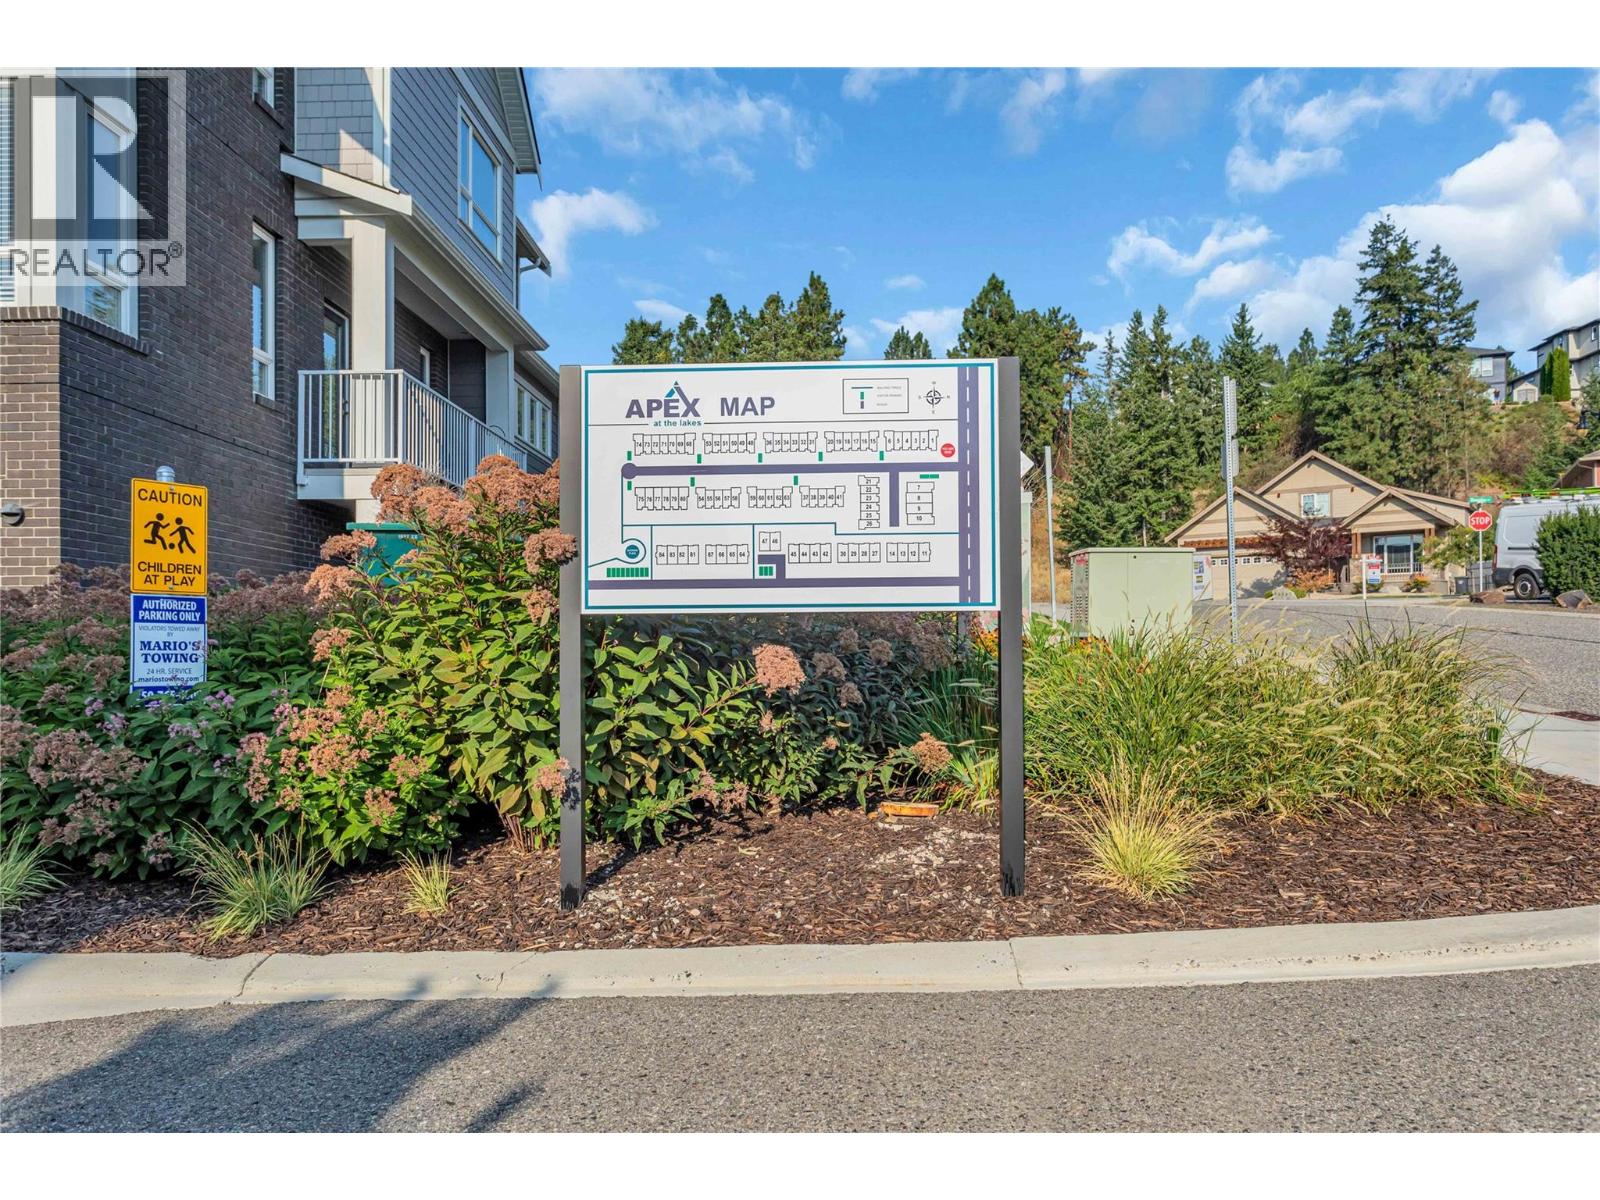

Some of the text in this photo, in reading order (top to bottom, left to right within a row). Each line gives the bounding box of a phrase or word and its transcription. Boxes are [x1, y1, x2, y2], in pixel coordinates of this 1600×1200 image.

[625, 387, 776, 418] APEX MAP
[138, 488, 202, 507] CAUTION
[1470, 517, 1490, 525] STOP
[138, 561, 201, 574] CHILDREN
[144, 574, 195, 586] AT PLAY
[142, 599, 197, 610] AUTHORIZED
[139, 610, 200, 621] PARKING ONLY
[140, 641, 200, 651] MARIO'S
[141, 653, 199, 663] TOWING
